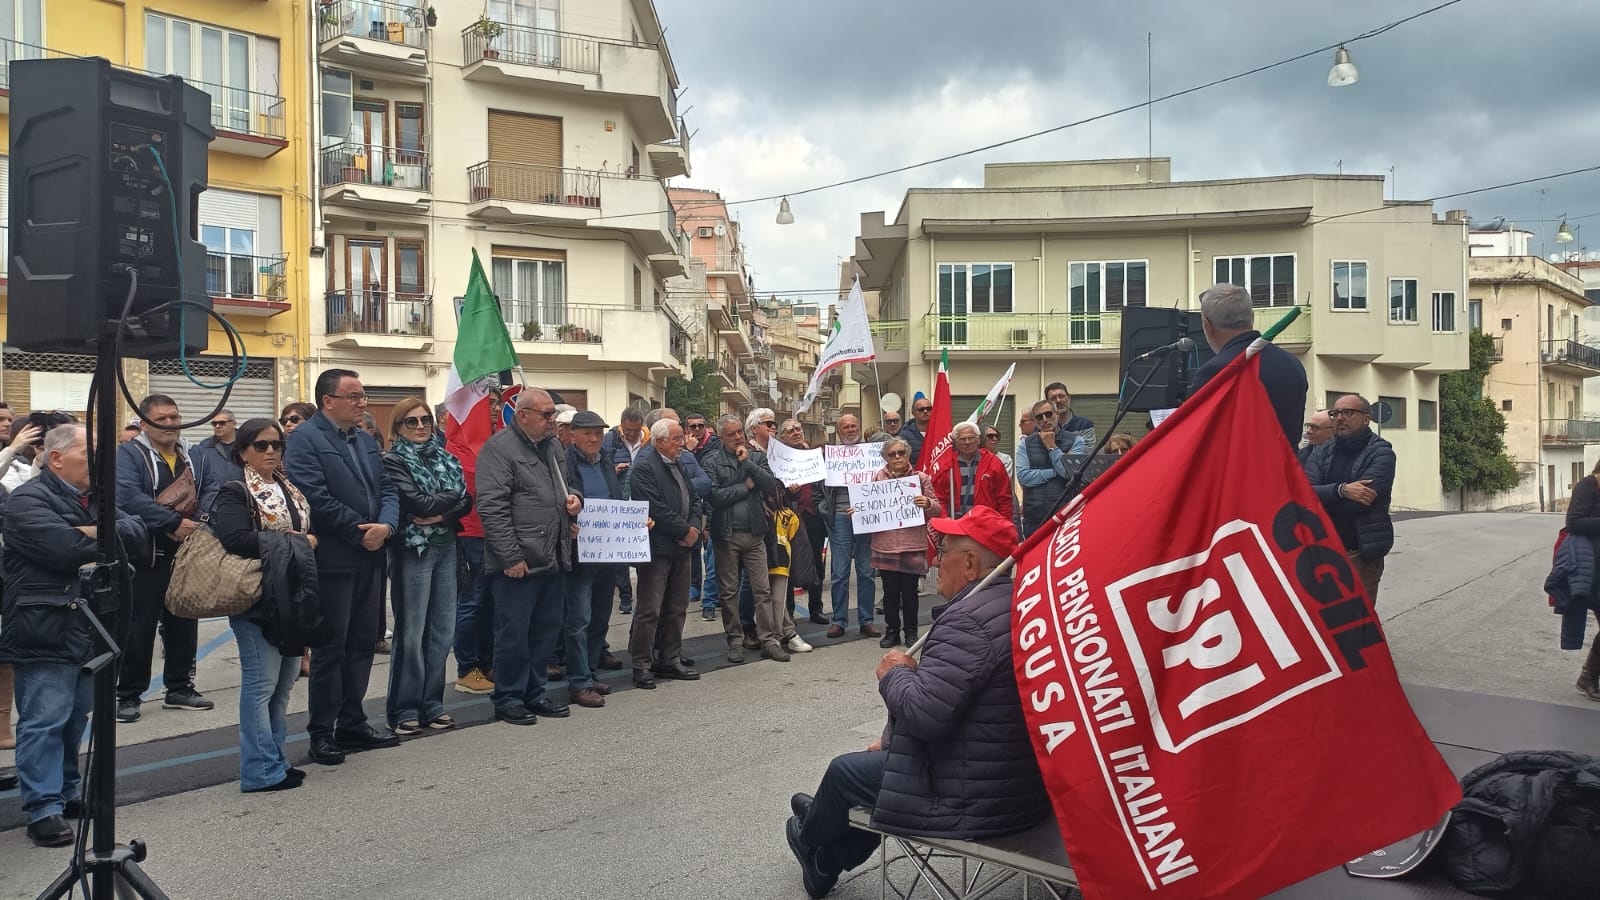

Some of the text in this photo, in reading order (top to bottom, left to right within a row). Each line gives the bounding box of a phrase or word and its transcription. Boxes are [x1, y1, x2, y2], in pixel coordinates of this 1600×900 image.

[827, 446, 864, 459] URGENZA
[611, 504, 618, 514] DI
[620, 505, 648, 515] PERSONE
[854, 494, 915, 513] SE NON LA CUR
[577, 519, 646, 530] NON HANNO UN MEDICO
[861, 514, 881, 525] NON
[882, 511, 893, 523] TI
[588, 535, 602, 543] BASE
[581, 550, 596, 559] NON
[616, 550, 648, 559] PROBLEMA
[1272, 500, 1384, 673] CGIL
[1146, 577, 1267, 721] SPI
[1016, 564, 1077, 756] RAGUSA
[1056, 566, 1137, 735] PENSIONATI
[1109, 744, 1199, 886] ITALIANI
